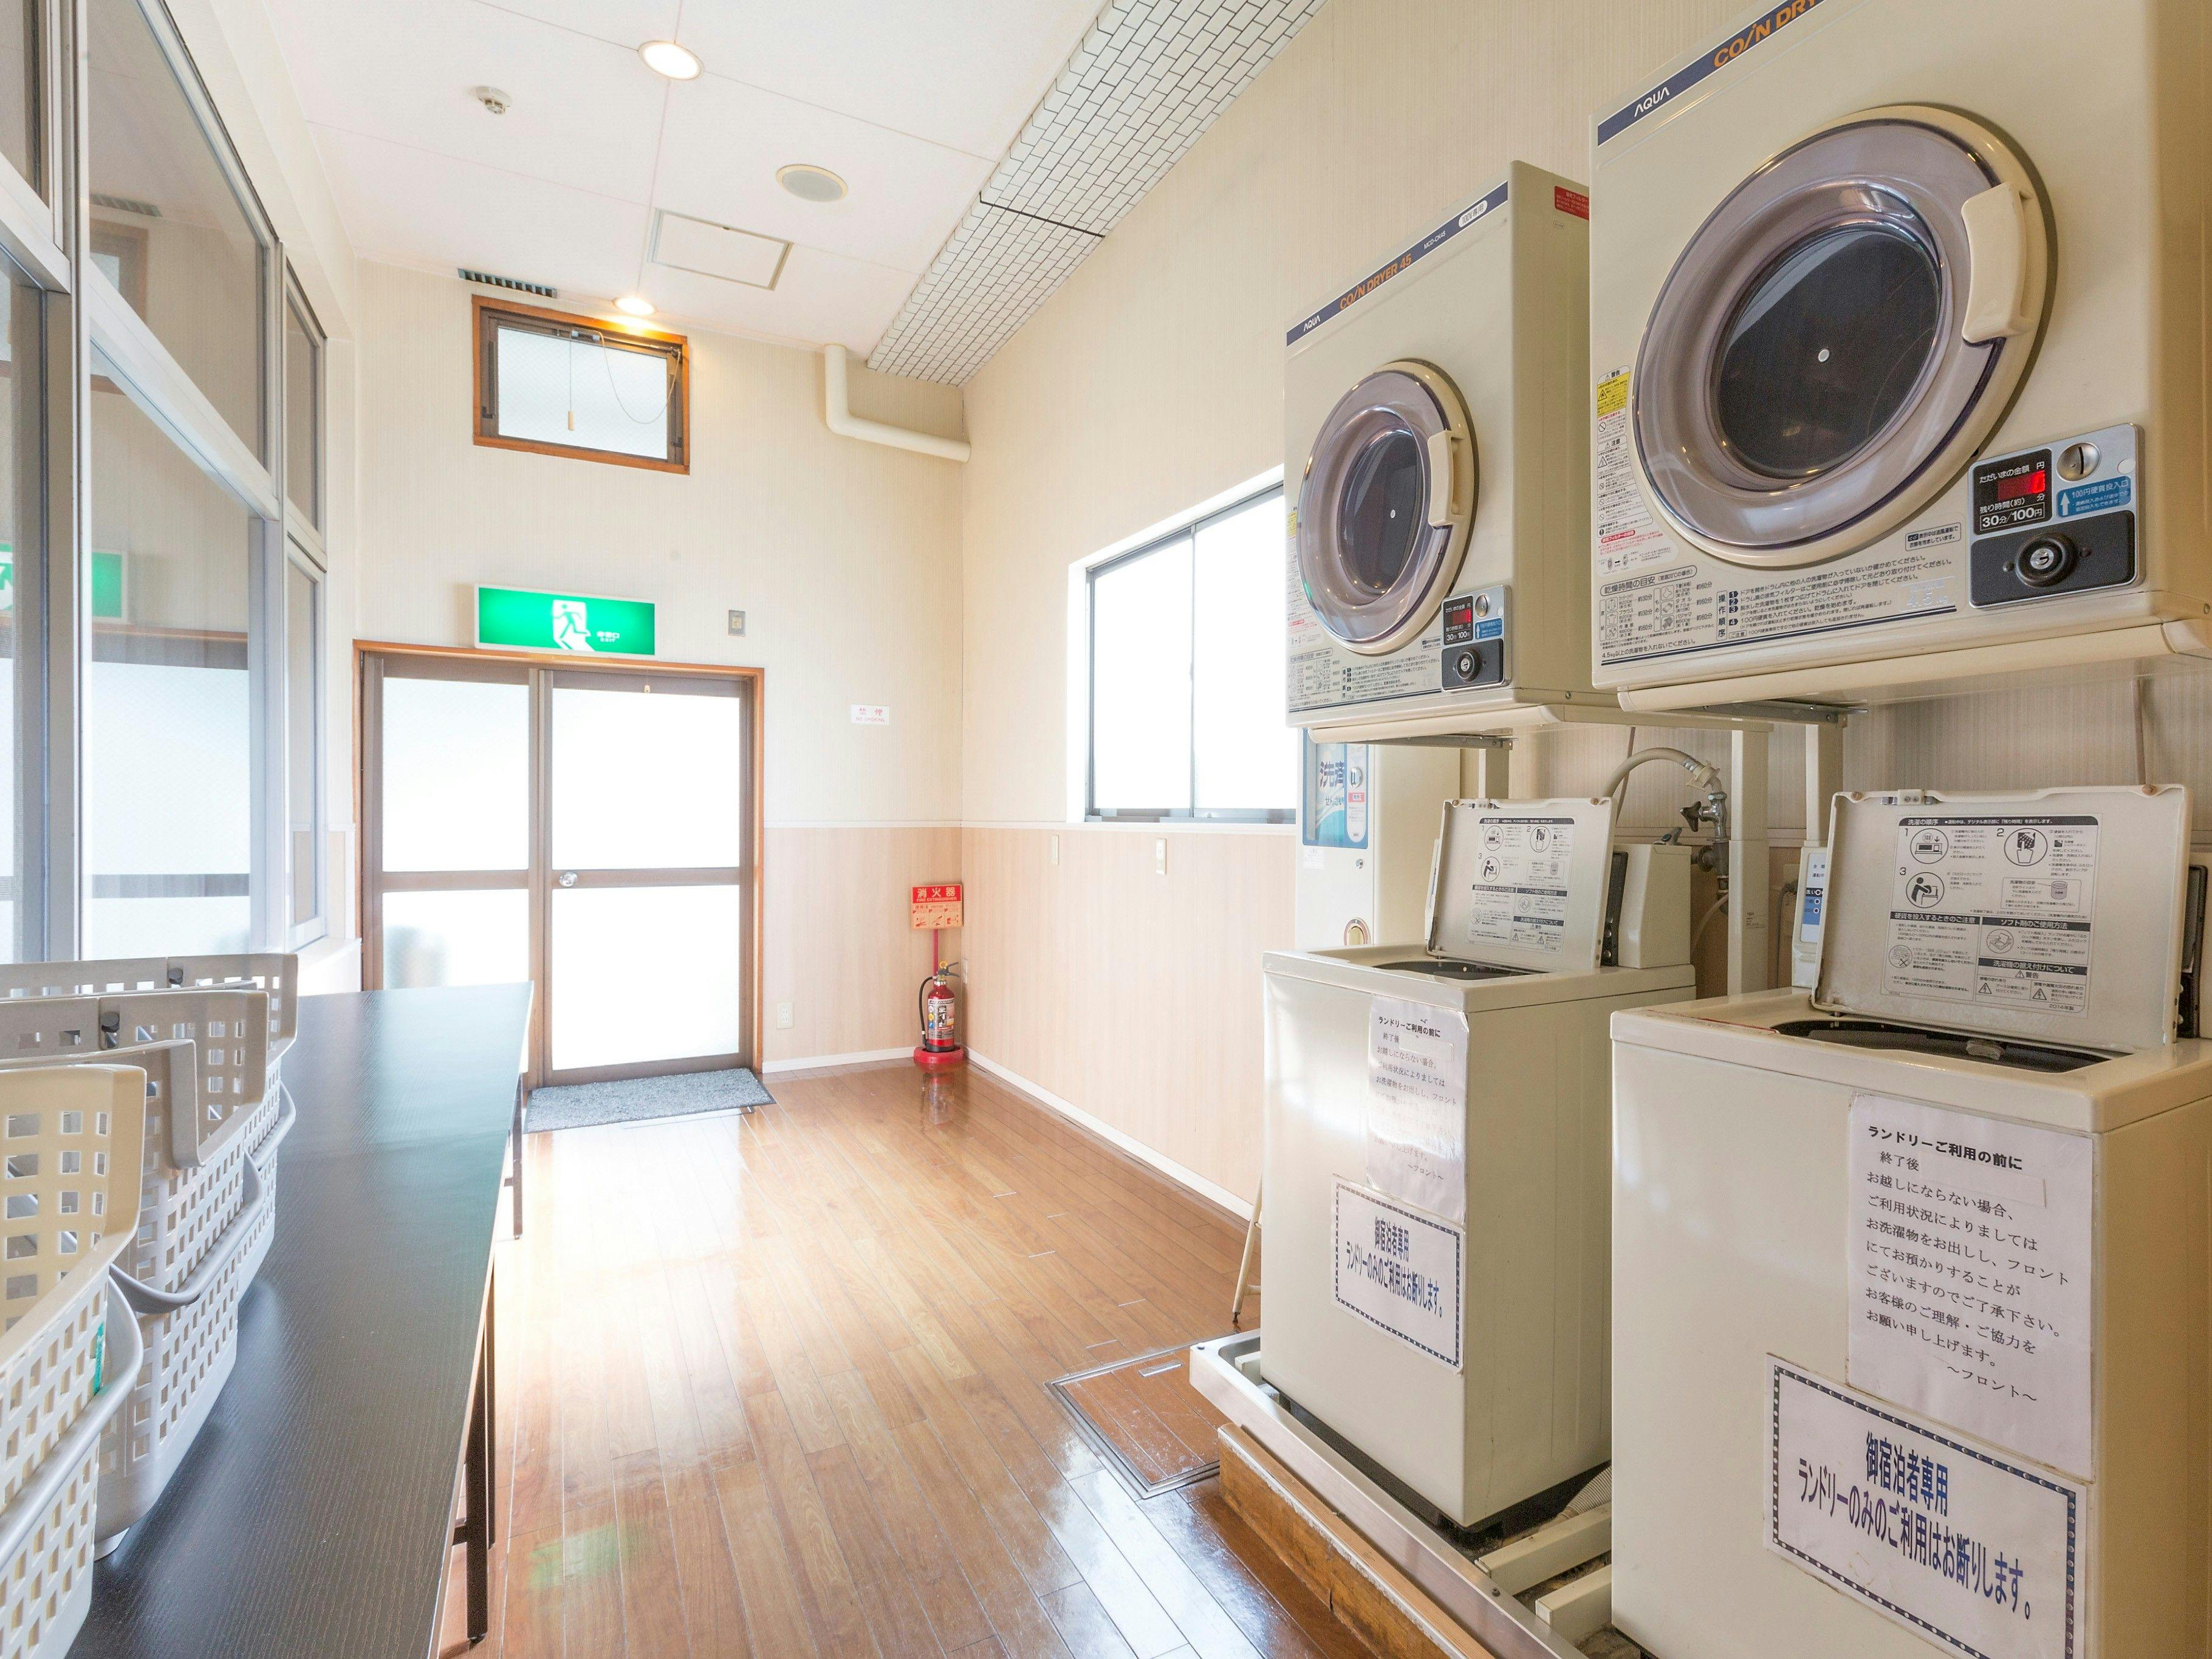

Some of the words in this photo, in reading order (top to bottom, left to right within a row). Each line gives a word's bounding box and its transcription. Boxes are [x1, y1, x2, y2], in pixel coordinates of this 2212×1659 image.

[1634, 86, 1670, 117] AQUA
[1367, 262, 1397, 293] DRYER
[1400, 253, 1411, 269] 45
[1303, 315, 1320, 331] AQUA
[1979, 465, 2030, 484] ただいまの金額
[2036, 461, 2045, 470] 円
[2072, 480, 2128, 498] 100円硬貨投入口
[1604, 576, 1656, 593] 乾燥時間の目安
[1996, 828, 2004, 836] 2
[918, 887, 956, 898] 消火器
[1894, 913, 1976, 923] 硬貨を投入するときのご注意
[2001, 919, 2067, 929] ソフト剤のご使用方法
[1993, 960, 2075, 974] 洗濯機の据え付けについて
[1378, 1016, 1440, 1037] ランドリーご利用の前に
[1383, 1032, 1400, 1043] 終了後
[1376, 1045, 1436, 1069] お越しにならない場合、
[1868, 1126, 2022, 1170] ランドリーご利用の前に
[1880, 1151, 1919, 1171] 終了後
[1867, 1172, 2013, 1220] お越しにならない場合、
[1868, 1195, 2038, 1251] ご利用状況によりましては
[1866, 1218, 2068, 1285] お洗濯物をお出しし、フロント
[1346, 1241, 1442, 1318] ランドリーのみのご利用はお断りします。
[1866, 1240, 2021, 1296] にてお預かりすることが
[1866, 1264, 2060, 1337] ございますのでご了承下さい。
[1866, 1287, 2036, 1355] お客様のご理解・ご協力を
[1866, 1310, 1996, 1367] お願い申し上げます。
[1866, 1431, 1948, 1517] 御宿泊者専用
[1798, 1458, 2030, 1620] ランドリーのみのご利用はお断りします。
